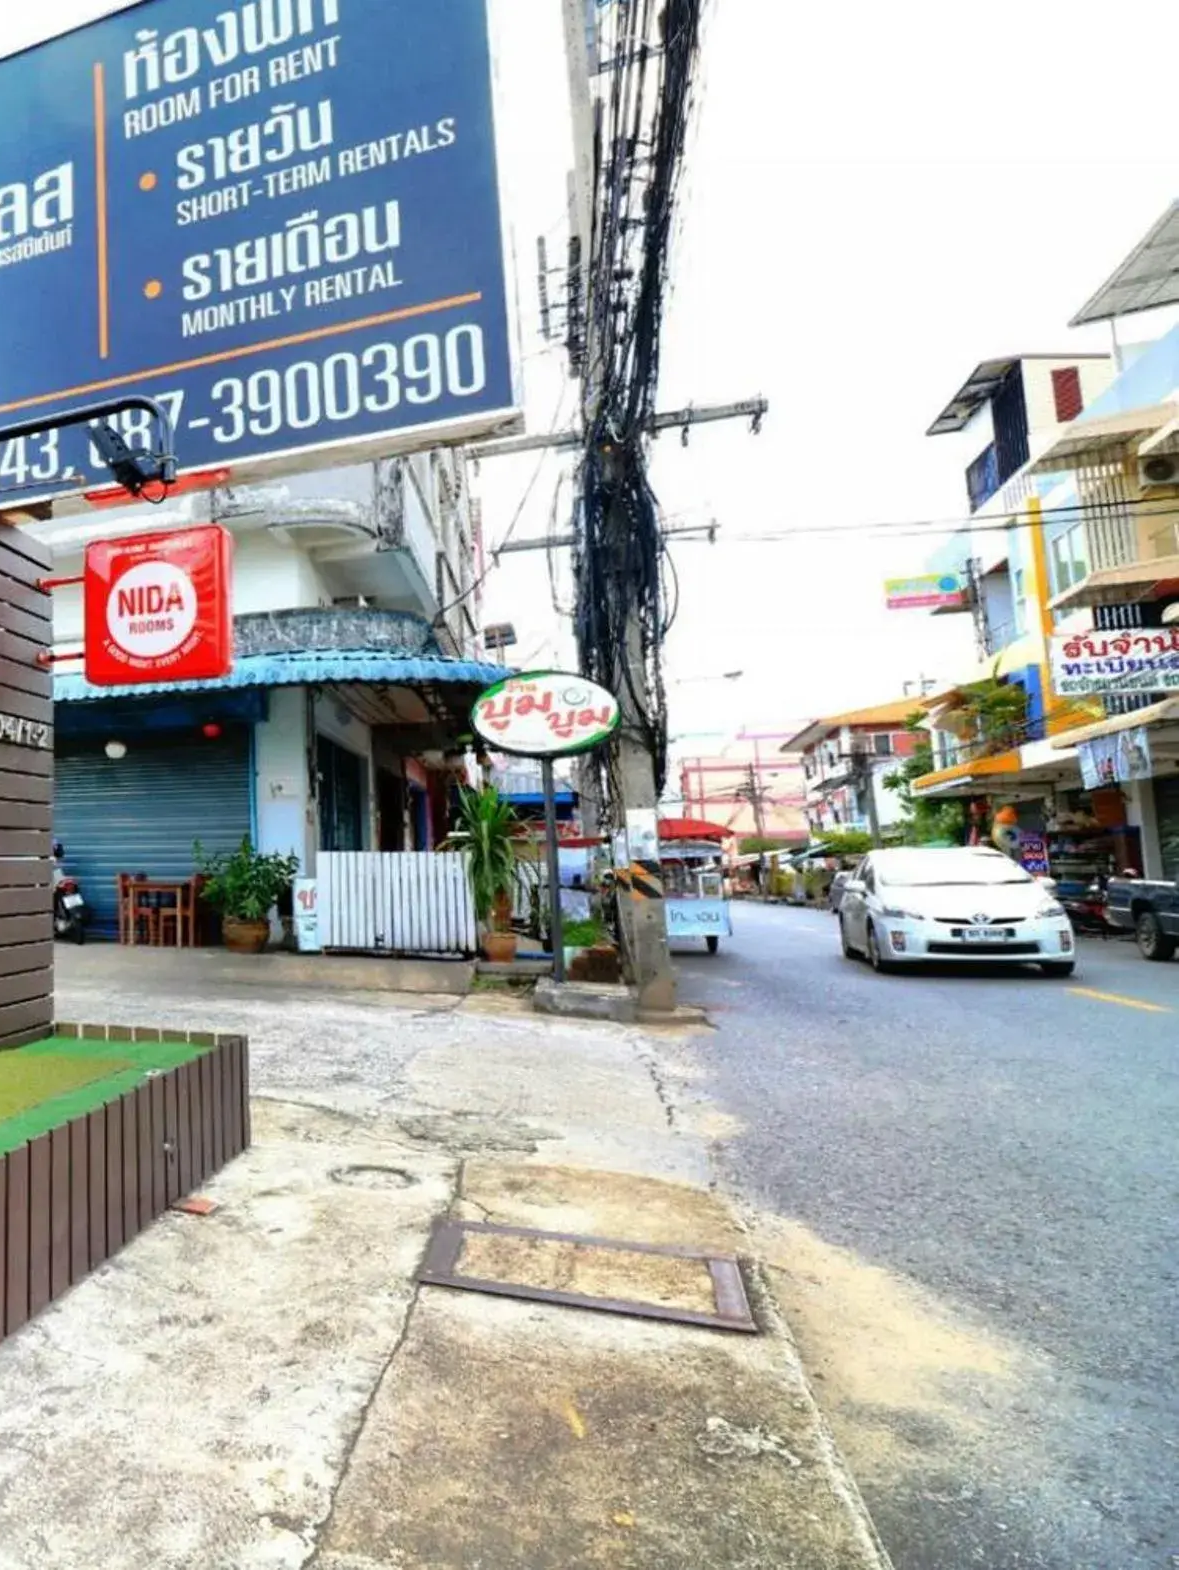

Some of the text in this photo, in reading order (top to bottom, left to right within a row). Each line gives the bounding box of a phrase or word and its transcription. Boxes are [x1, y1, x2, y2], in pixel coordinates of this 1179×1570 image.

[125, 35, 341, 139] ROOM FOR RENT
[176, 99, 334, 191] รายวัน
[176, 117, 456, 226] SHORT-TERM RENTALS
[182, 200, 401, 301] รายเดือน
[181, 260, 403, 338] MONTHLY RENTAL
[117, 581, 185, 618] NIDA
[128, 618, 175, 635] ROOMS
[1062, 627, 1179, 658] รับจำน
